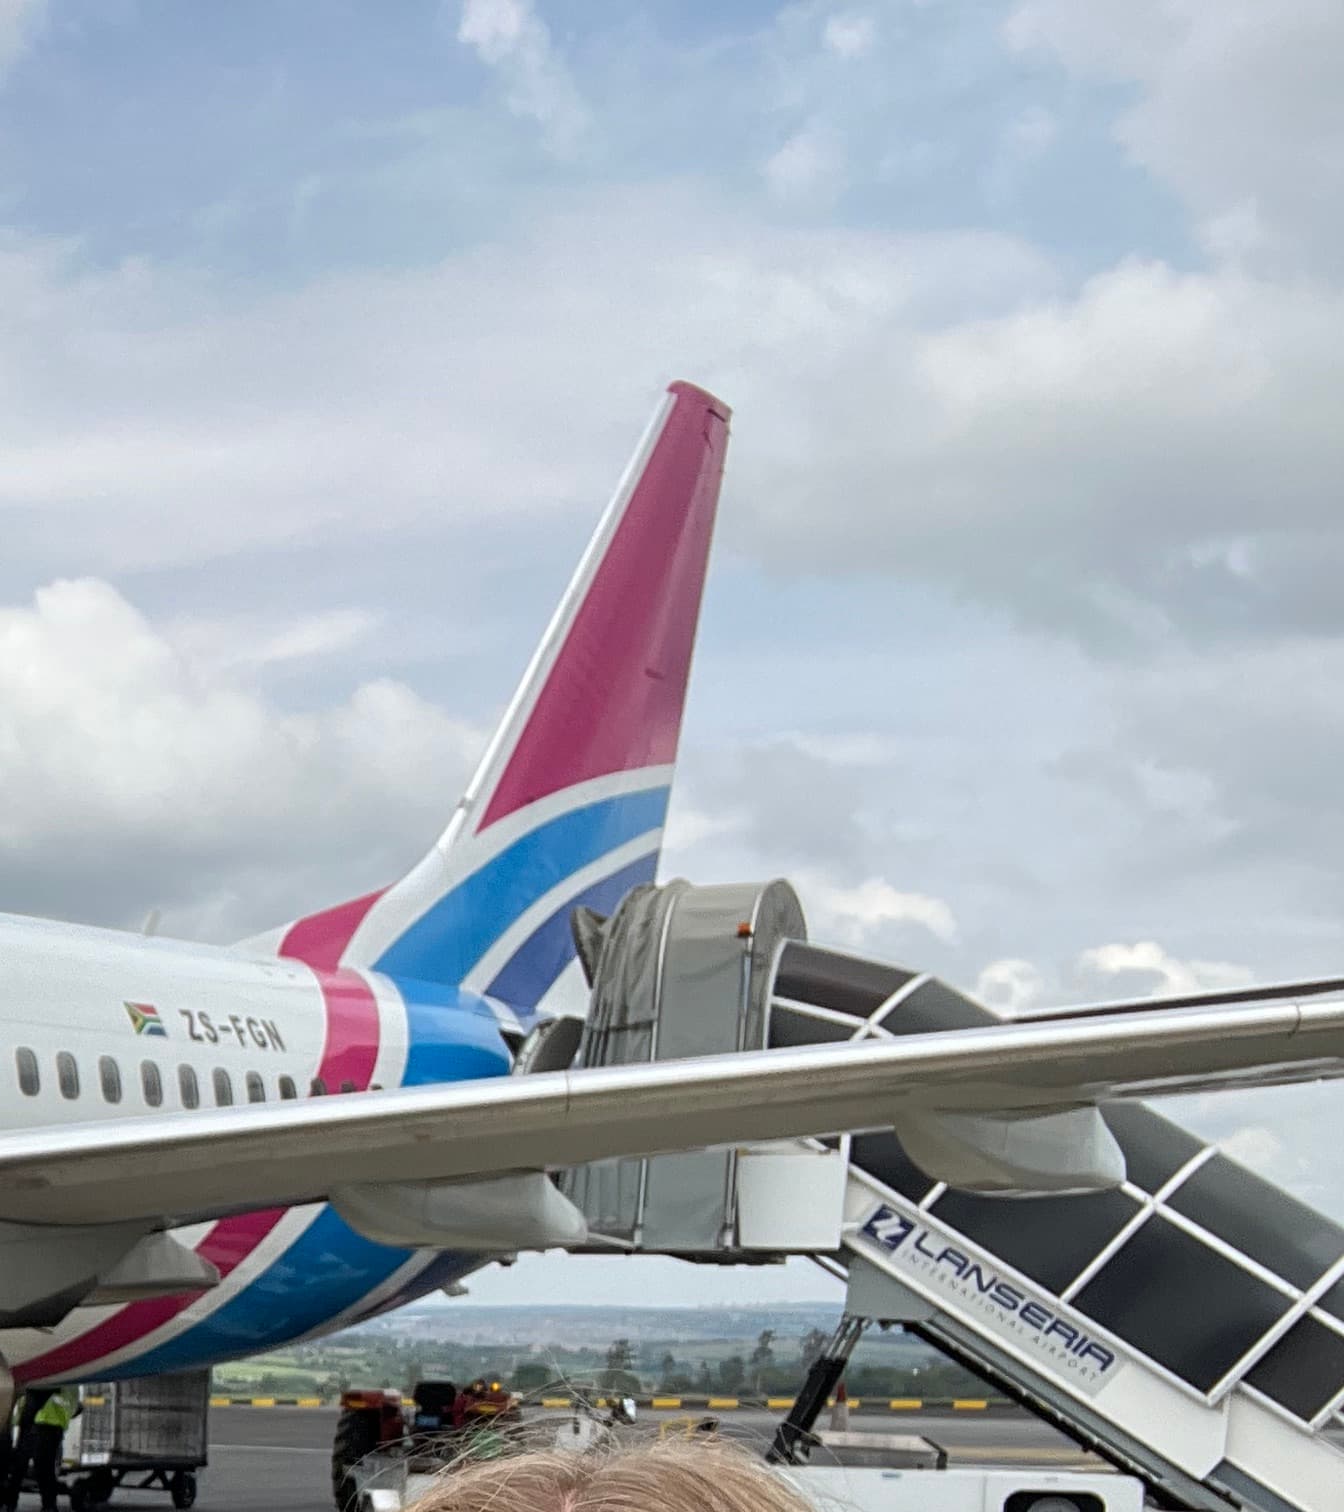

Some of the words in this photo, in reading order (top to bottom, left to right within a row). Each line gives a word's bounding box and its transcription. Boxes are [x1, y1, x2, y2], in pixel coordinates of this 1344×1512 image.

[178, 1009, 286, 1052] ZS-FGN
[901, 1249, 1023, 1334] INTERNATIONAL
[1032, 1335, 1097, 1381] AIRPORT
[914, 1231, 1116, 1373] LANSERIA
